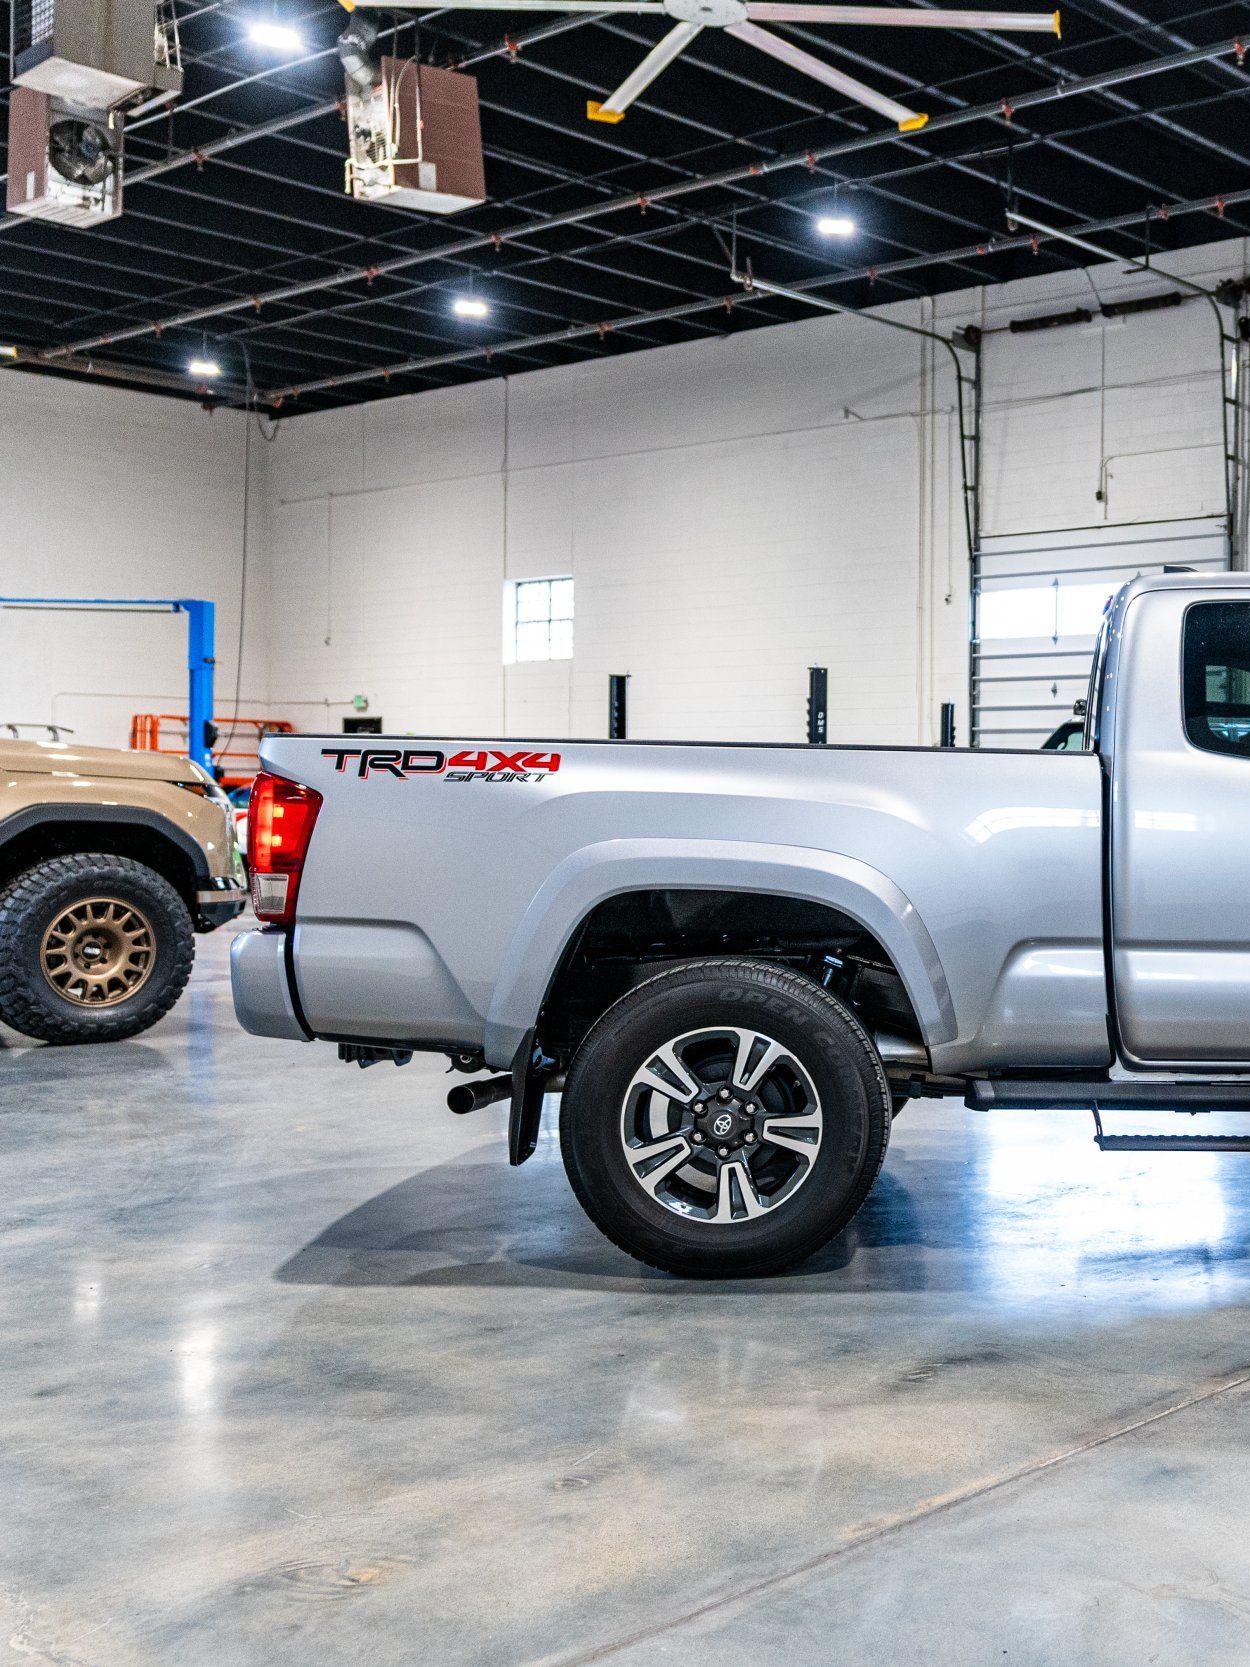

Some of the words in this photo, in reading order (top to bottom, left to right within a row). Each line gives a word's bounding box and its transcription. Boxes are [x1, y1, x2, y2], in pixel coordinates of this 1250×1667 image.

[321, 748, 447, 781] TRD
[443, 771, 554, 783] SPORT
[719, 987, 809, 1026] OPEN
